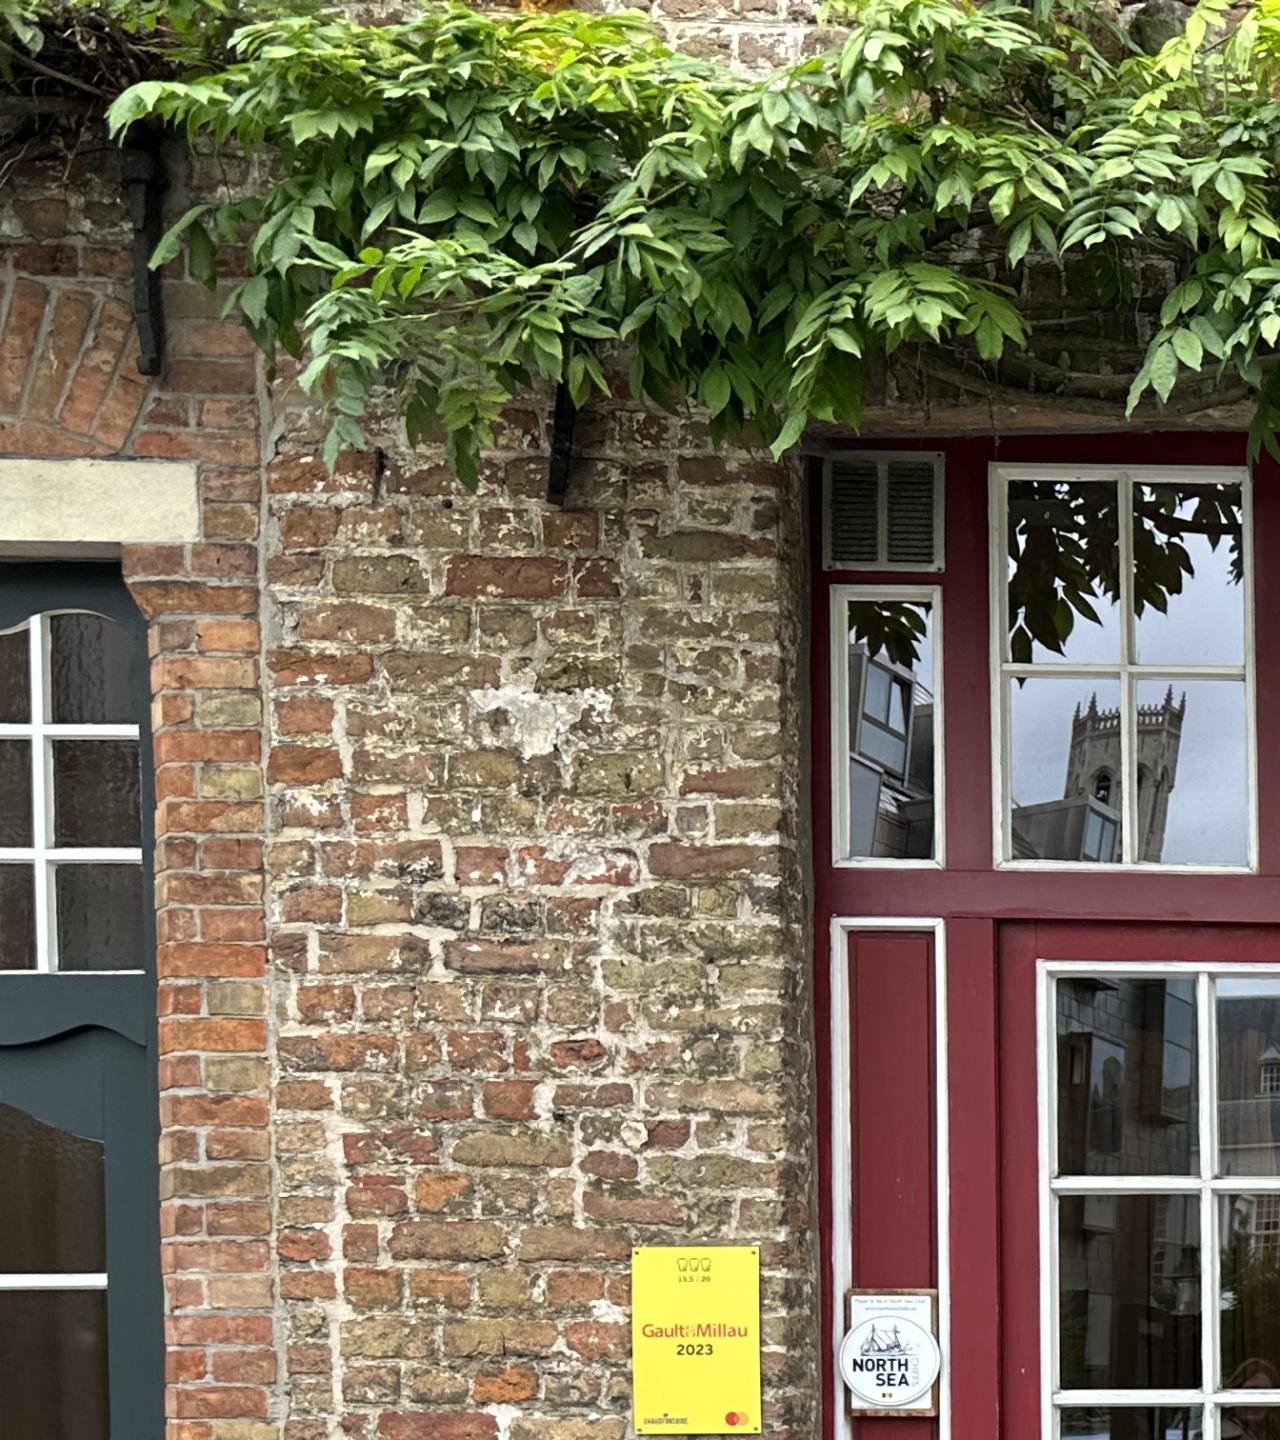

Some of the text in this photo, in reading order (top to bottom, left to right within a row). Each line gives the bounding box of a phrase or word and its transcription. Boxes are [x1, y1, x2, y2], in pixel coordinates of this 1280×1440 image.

[676, 1344, 714, 1356] 2023
[852, 1358, 908, 1372] NORTH
[876, 1373, 909, 1387] SEA
